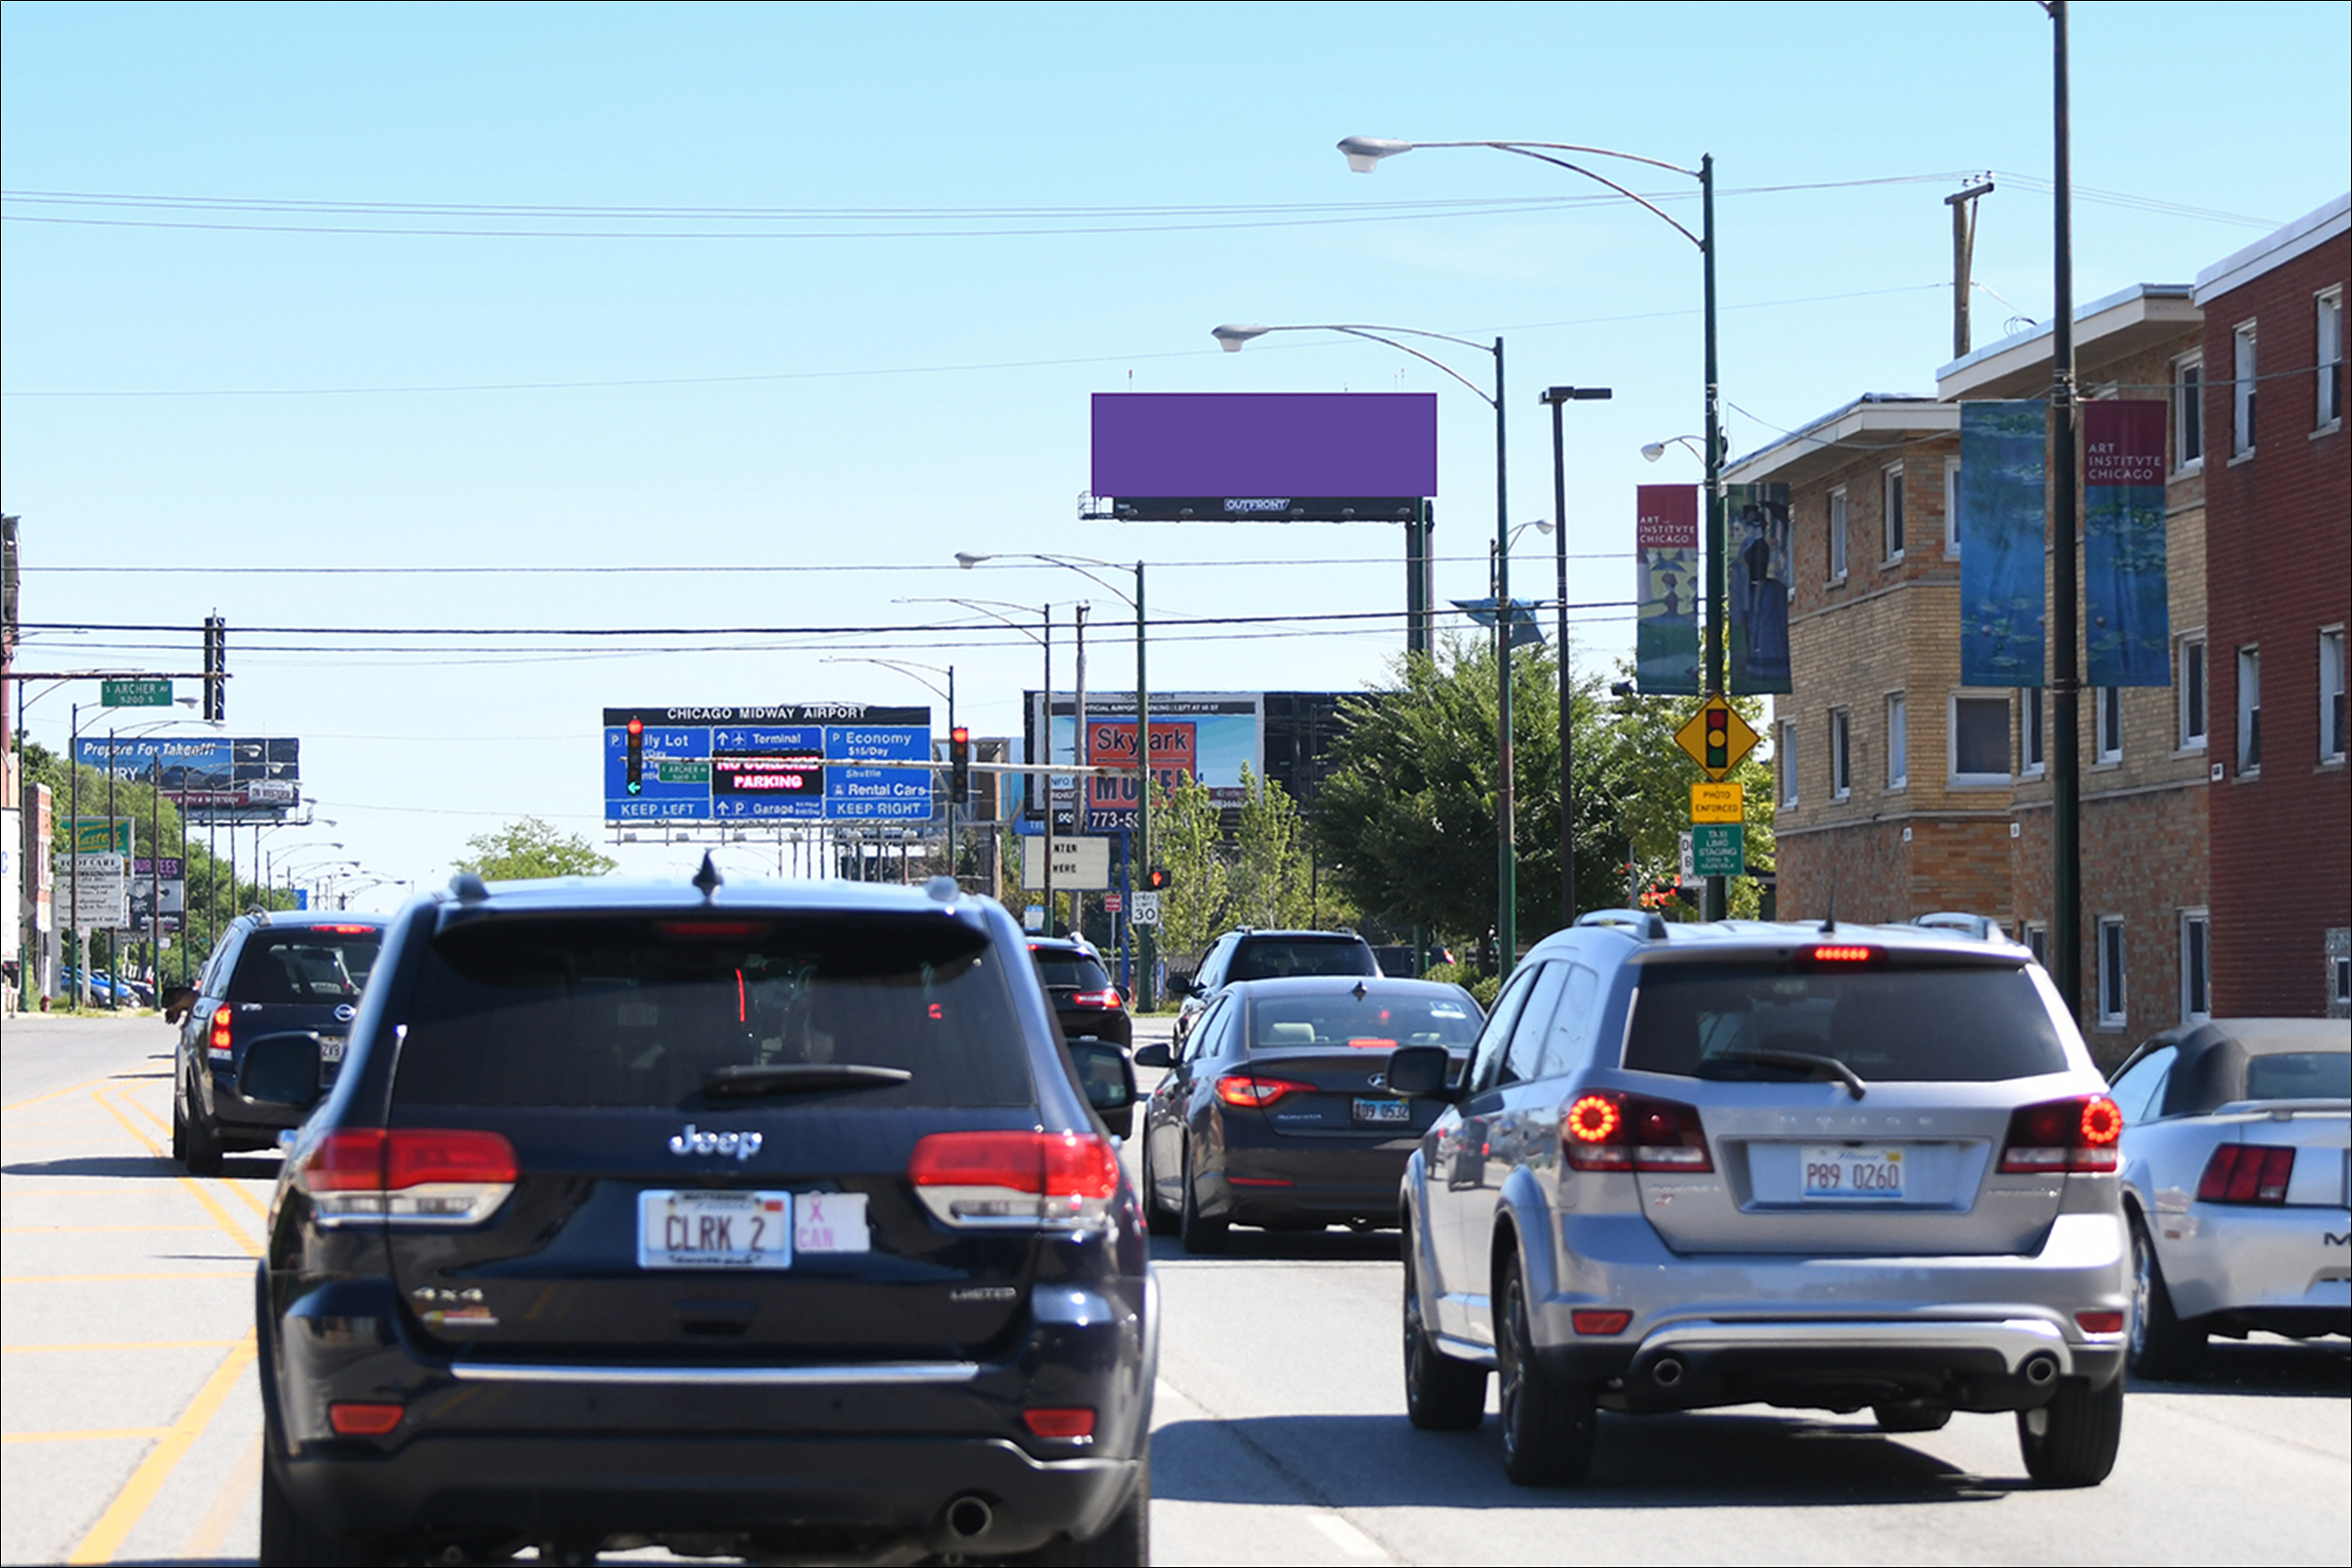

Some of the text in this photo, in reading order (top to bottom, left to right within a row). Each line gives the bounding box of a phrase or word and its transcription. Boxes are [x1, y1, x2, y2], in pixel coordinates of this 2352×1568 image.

[2088, 443, 2115, 454] ART
[2088, 456, 2162, 466] INSTITVTE
[2088, 468, 2154, 480] CHICAGO
[1225, 499, 1290, 511] OUTFRONT
[1640, 515, 1660, 524] ART
[1640, 525, 1695, 534] INSTITVTE
[1640, 535, 1690, 544] CHICAGO
[114, 684, 156, 695] ARCHER
[667, 707, 867, 719] CHICAGO MIDWAY AIRPORT
[625, 734, 661, 749] ily
[665, 735, 689, 747] Lot
[753, 733, 802, 744] Terminal
[846, 732, 912, 746] Economy
[1097, 727, 1190, 757] Skyark
[848, 746, 889, 758] $15/Day
[846, 769, 882, 779] Shuttle
[733, 774, 805, 789] PARKING
[848, 783, 927, 796] Rental Cars
[1702, 790, 1732, 800] PHOTO
[621, 804, 695, 815] KEEP LEFT
[754, 803, 795, 815] Garage
[837, 804, 921, 814] KEEP RIGHT
[1694, 804, 1740, 813] ENFORCED
[1707, 830, 1728, 839] TAXI
[1054, 844, 1078, 854] NTER
[1698, 848, 1738, 858] STAGING
[1135, 907, 1156, 921] 30
[668, 1123, 762, 1161] Jeep
[1806, 1163, 1899, 1190] P89 0260
[666, 1215, 765, 1251] CLRK 2
[798, 1227, 834, 1249] CAN
